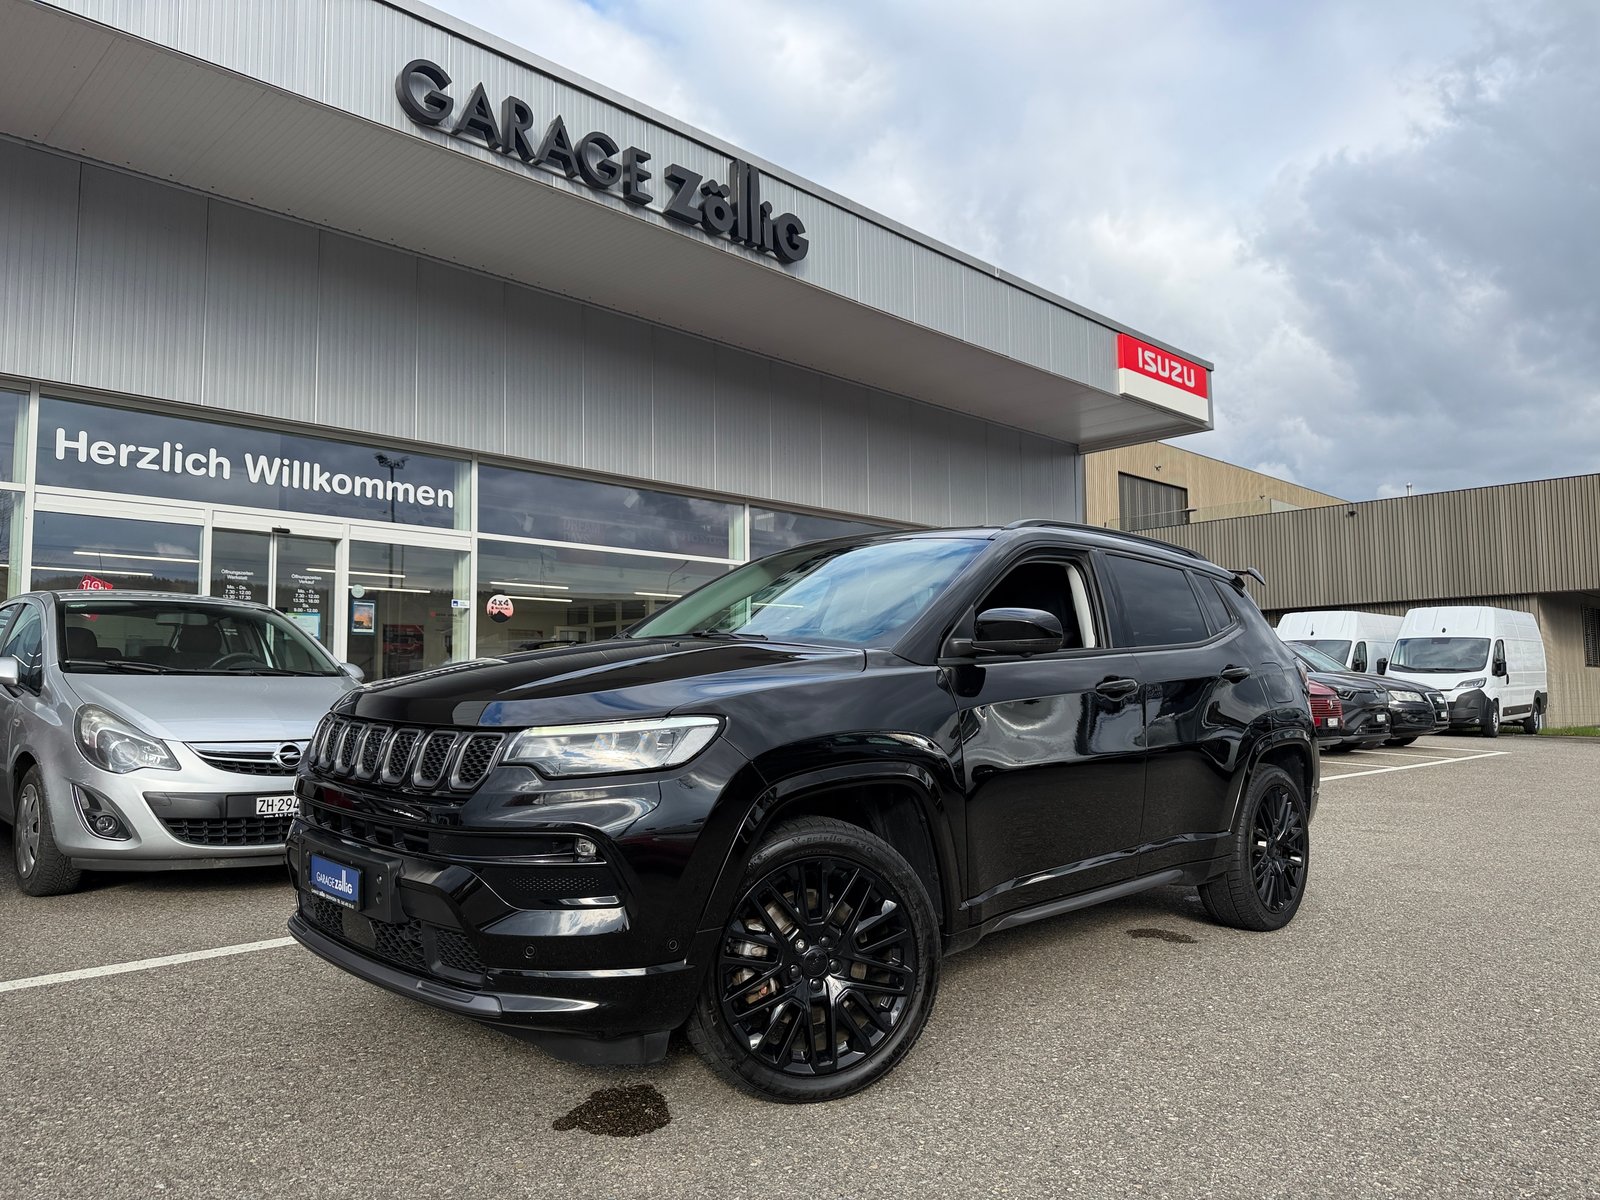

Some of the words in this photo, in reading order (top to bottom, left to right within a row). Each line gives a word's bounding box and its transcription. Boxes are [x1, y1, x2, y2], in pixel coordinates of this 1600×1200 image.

[395, 58, 654, 206] GARAGE
[1137, 346, 1195, 388] ISUZU
[55, 427, 231, 481] Herzlich
[244, 453, 454, 509] Willkommen
